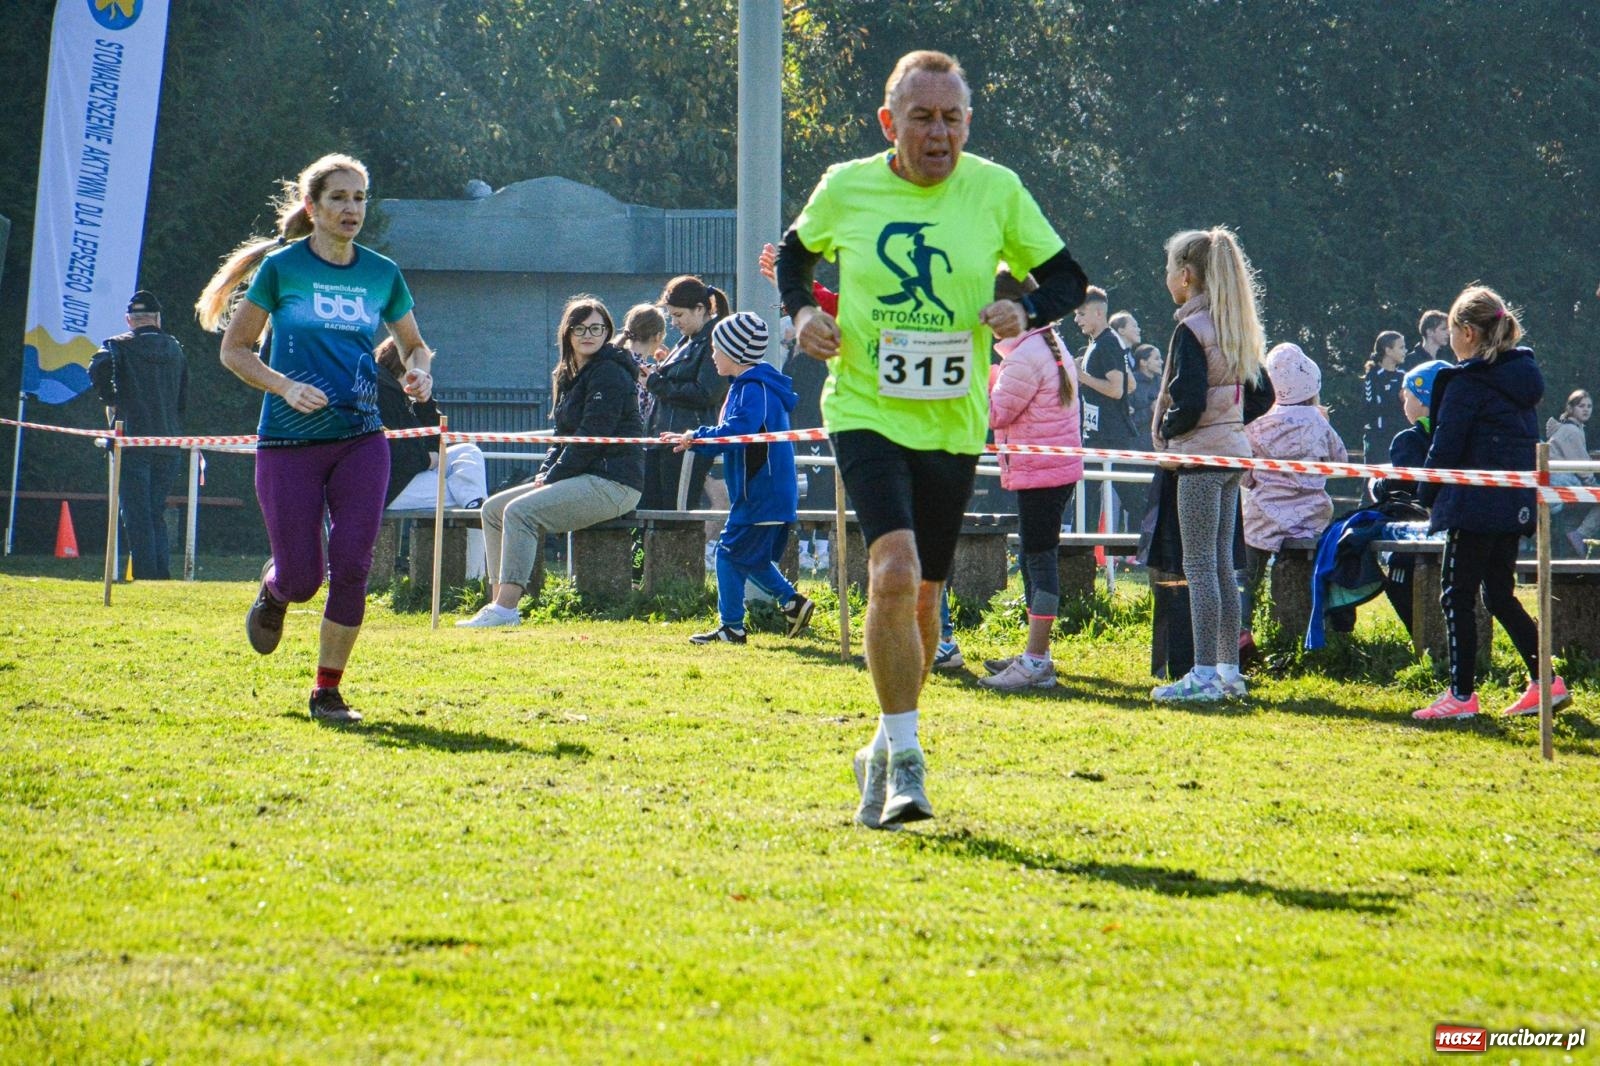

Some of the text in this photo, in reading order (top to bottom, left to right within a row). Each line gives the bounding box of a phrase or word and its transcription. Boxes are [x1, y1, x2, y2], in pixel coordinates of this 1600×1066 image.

[62, 38, 124, 334] STOWARZYSZENIE AKTYWNI DLA LEPSZEGO JUTRA
[313, 292, 371, 324] bbl
[872, 309, 945, 326] BYTOMSKI
[884, 354, 965, 386] 315
